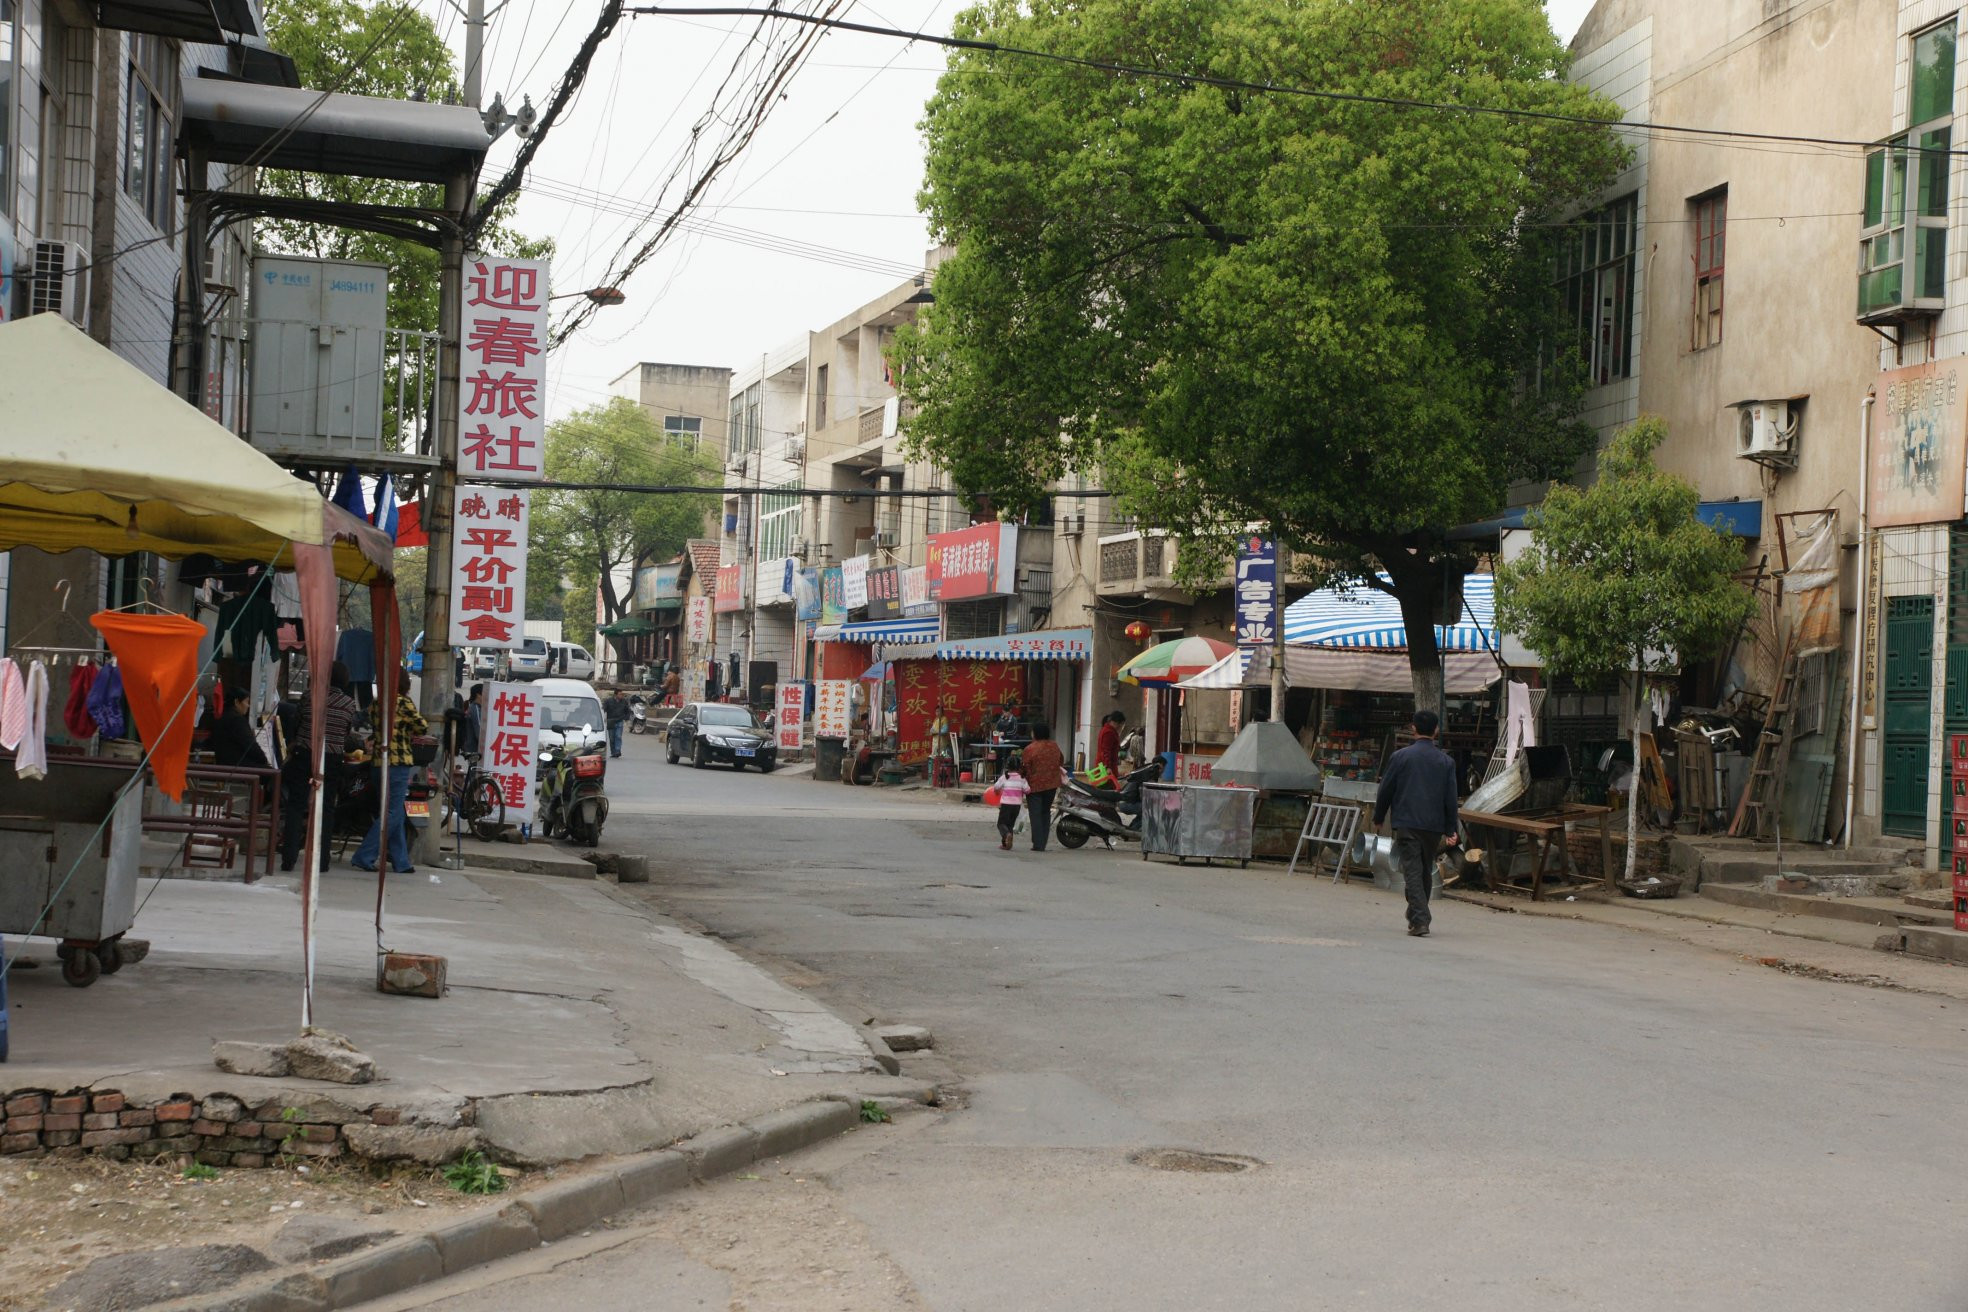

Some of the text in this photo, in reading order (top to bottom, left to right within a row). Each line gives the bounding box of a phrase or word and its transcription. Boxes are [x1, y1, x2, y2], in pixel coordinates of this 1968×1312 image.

[329, 280, 375, 293] J4894111
[462, 262, 542, 472] 迎春旅社
[458, 492, 525, 522] 晓晴
[457, 527, 518, 643] 平价副食
[1237, 557, 1275, 644] 广告专业
[485, 691, 535, 809] 性保健
[780, 686, 802, 747] 性保健
